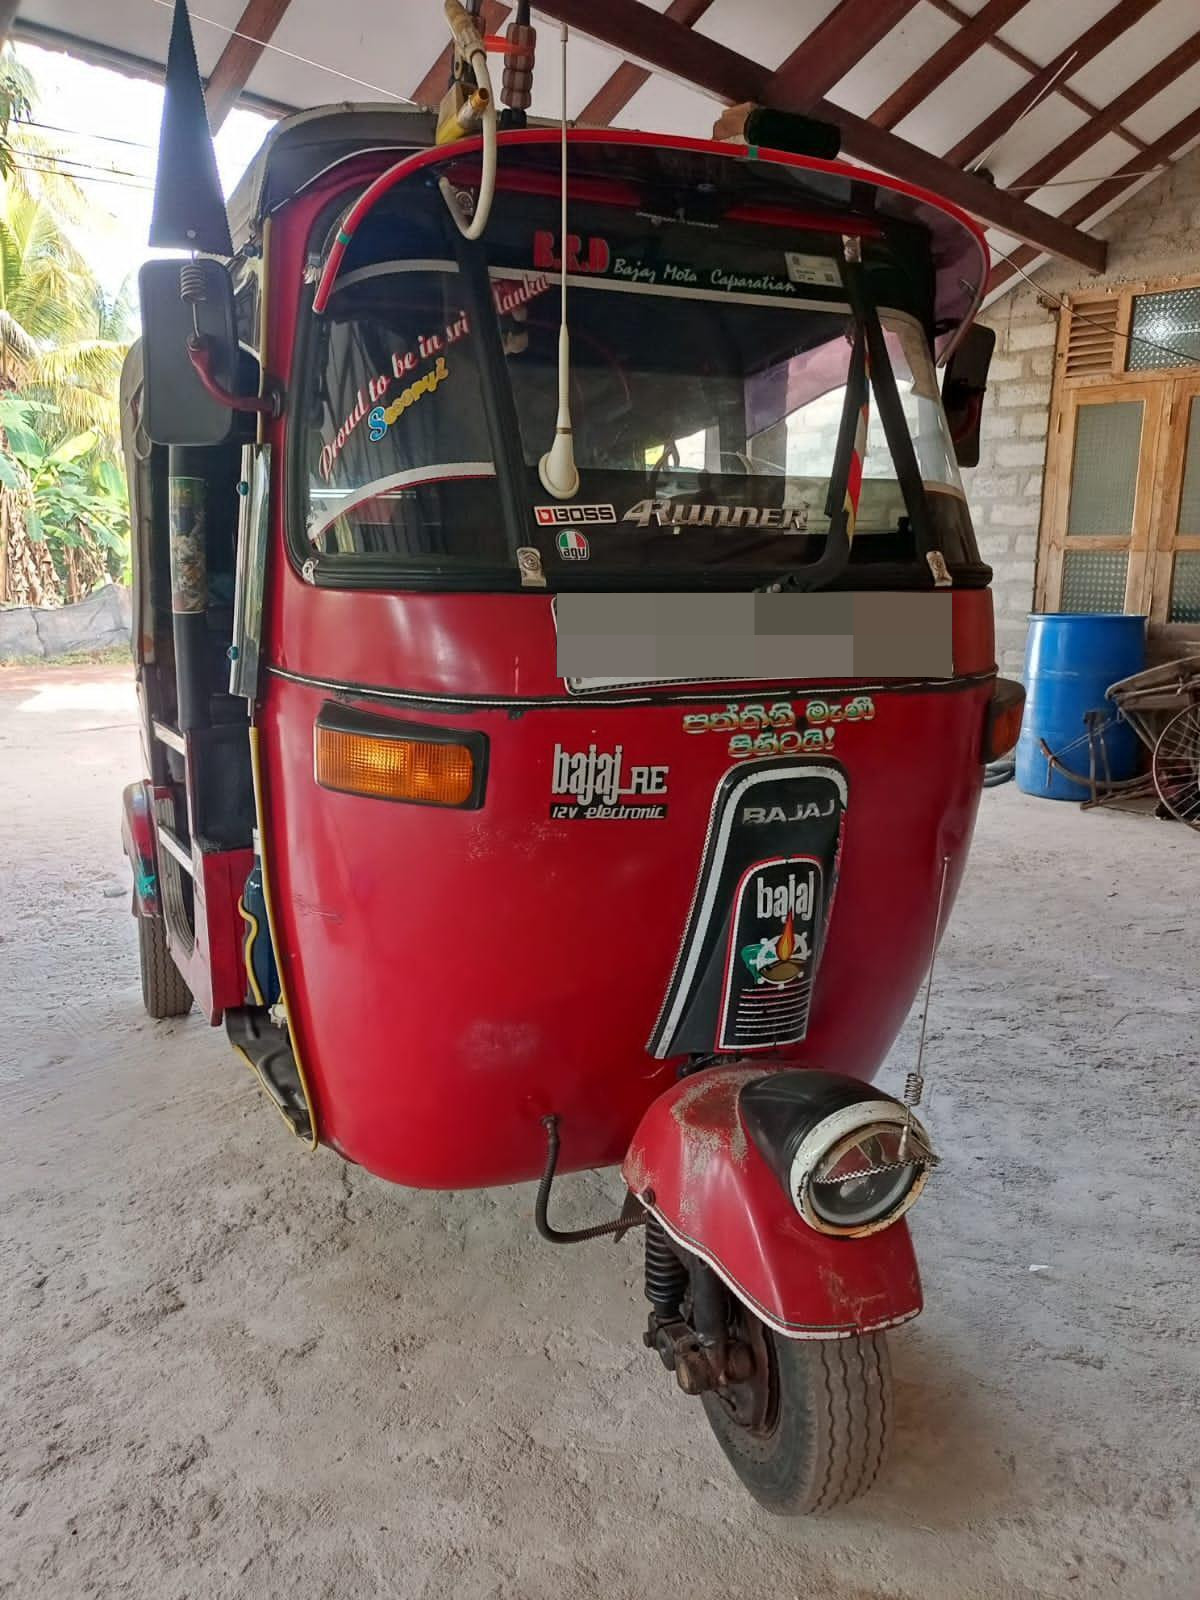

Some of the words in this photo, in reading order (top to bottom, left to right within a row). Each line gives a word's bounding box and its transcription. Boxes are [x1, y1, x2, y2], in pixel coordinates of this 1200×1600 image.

[533, 230, 610, 273] B.R.D
[319, 387, 370, 481] Proud
[368, 374, 391, 402] to
[391, 351, 417, 379] be
[417, 334, 443, 358] in
[552, 743, 622, 806] bajaj
[630, 766, 669, 794] RE
[552, 806, 579, 818] 12V
[584, 804, 665, 819] electronic
[742, 800, 835, 824] BAJAJ
[757, 871, 815, 923] bajaj
